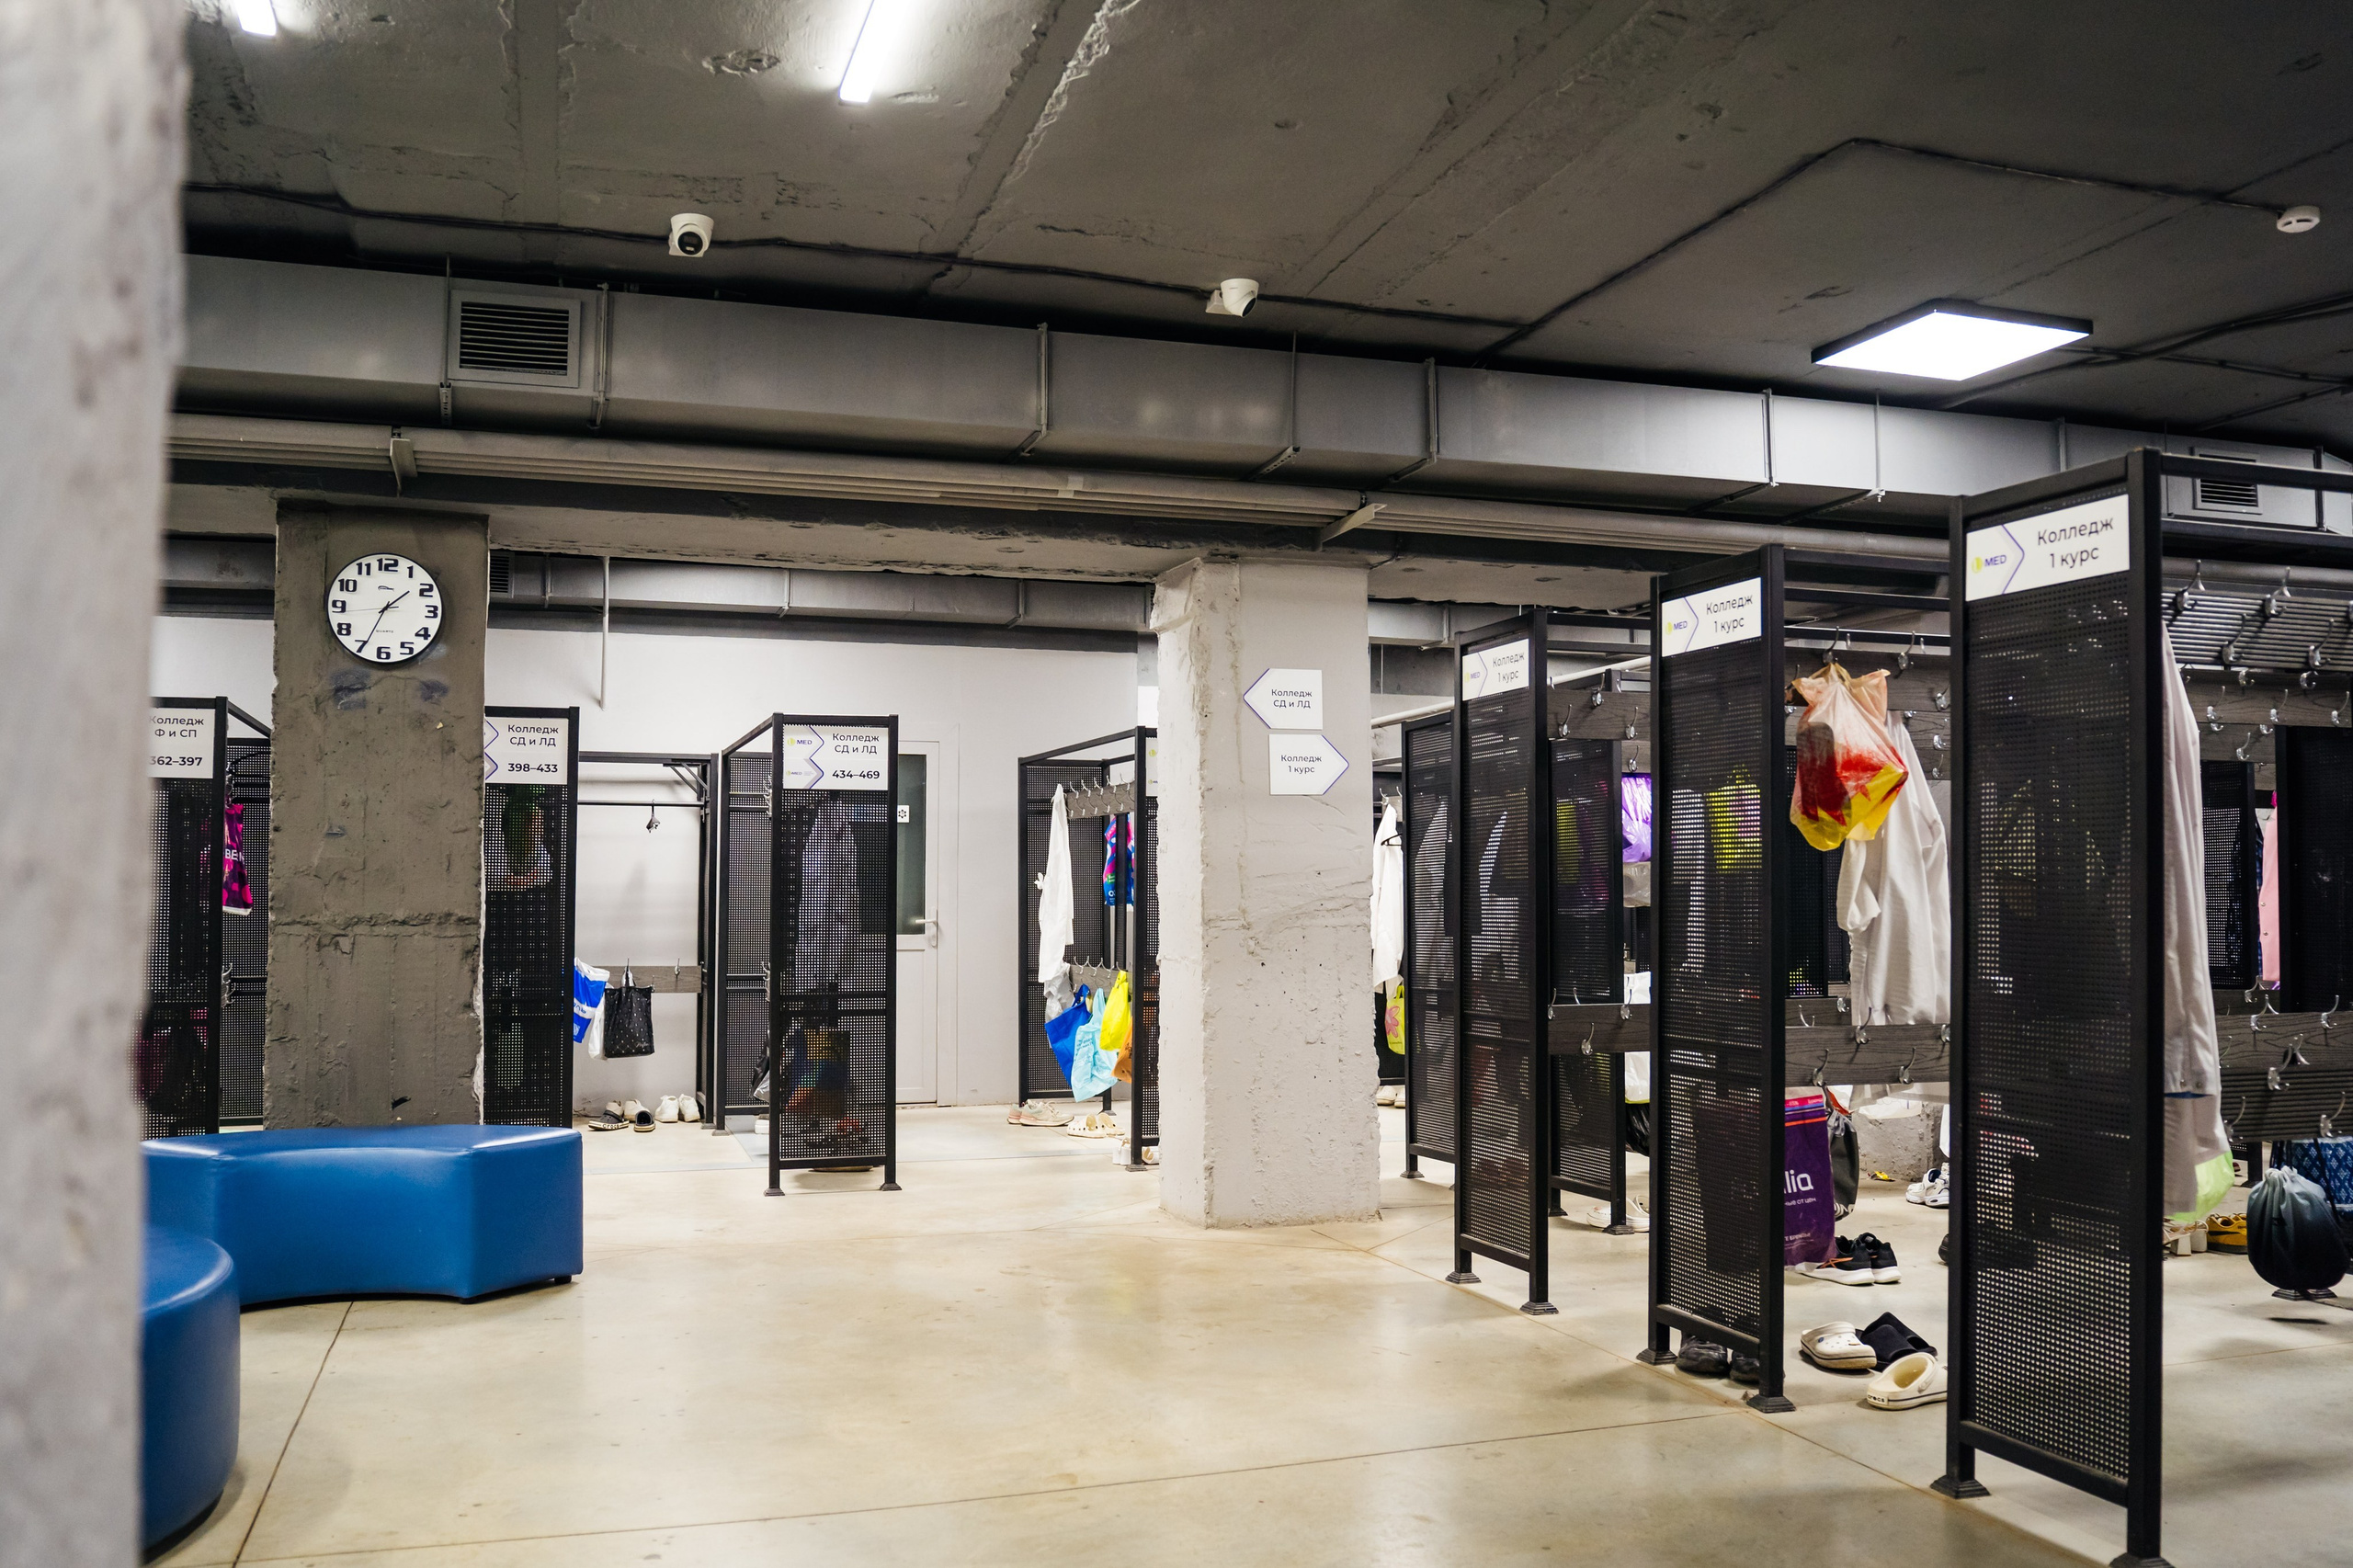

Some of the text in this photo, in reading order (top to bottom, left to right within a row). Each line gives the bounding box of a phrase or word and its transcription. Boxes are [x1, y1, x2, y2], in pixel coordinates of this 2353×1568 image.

[2038, 517, 2114, 546] Колледж
[2050, 547, 2099, 569] 1 курс
[356, 562, 371, 575] 11
[377, 558, 399, 572] 12
[407, 565, 414, 578] 1
[338, 578, 358, 592] 10
[419, 583, 434, 597] 2
[332, 599, 347, 613] 9
[1706, 595, 1753, 615] Колледж
[425, 605, 438, 619] 3
[336, 622, 352, 636] 8
[1714, 618, 1745, 634] 1 курс
[415, 627, 431, 641] 4
[355, 640, 369, 653] 7
[376, 646, 391, 660] 6
[400, 642, 415, 655] 5
[1492, 652, 1525, 667] Колледж
[1498, 670, 1519, 683] 1 курс
[1271, 688, 1313, 698] Колледж
[1273, 699, 1287, 708] СД
[1297, 700, 1312, 709] ЛД
[149, 715, 204, 726] Колледж
[154, 728, 165, 737] Ф
[179, 729, 197, 738] СП
[507, 724, 559, 734] Колледж
[509, 736, 527, 746] СД
[539, 737, 556, 747] ЛД
[832, 733, 880, 743] Колледж
[834, 744, 850, 754] СД
[861, 745, 878, 755] ЛД
[1280, 754, 1322, 763] Колледж
[1294, 767, 1315, 775] курс
[1784, 1169, 1814, 1194] lia
